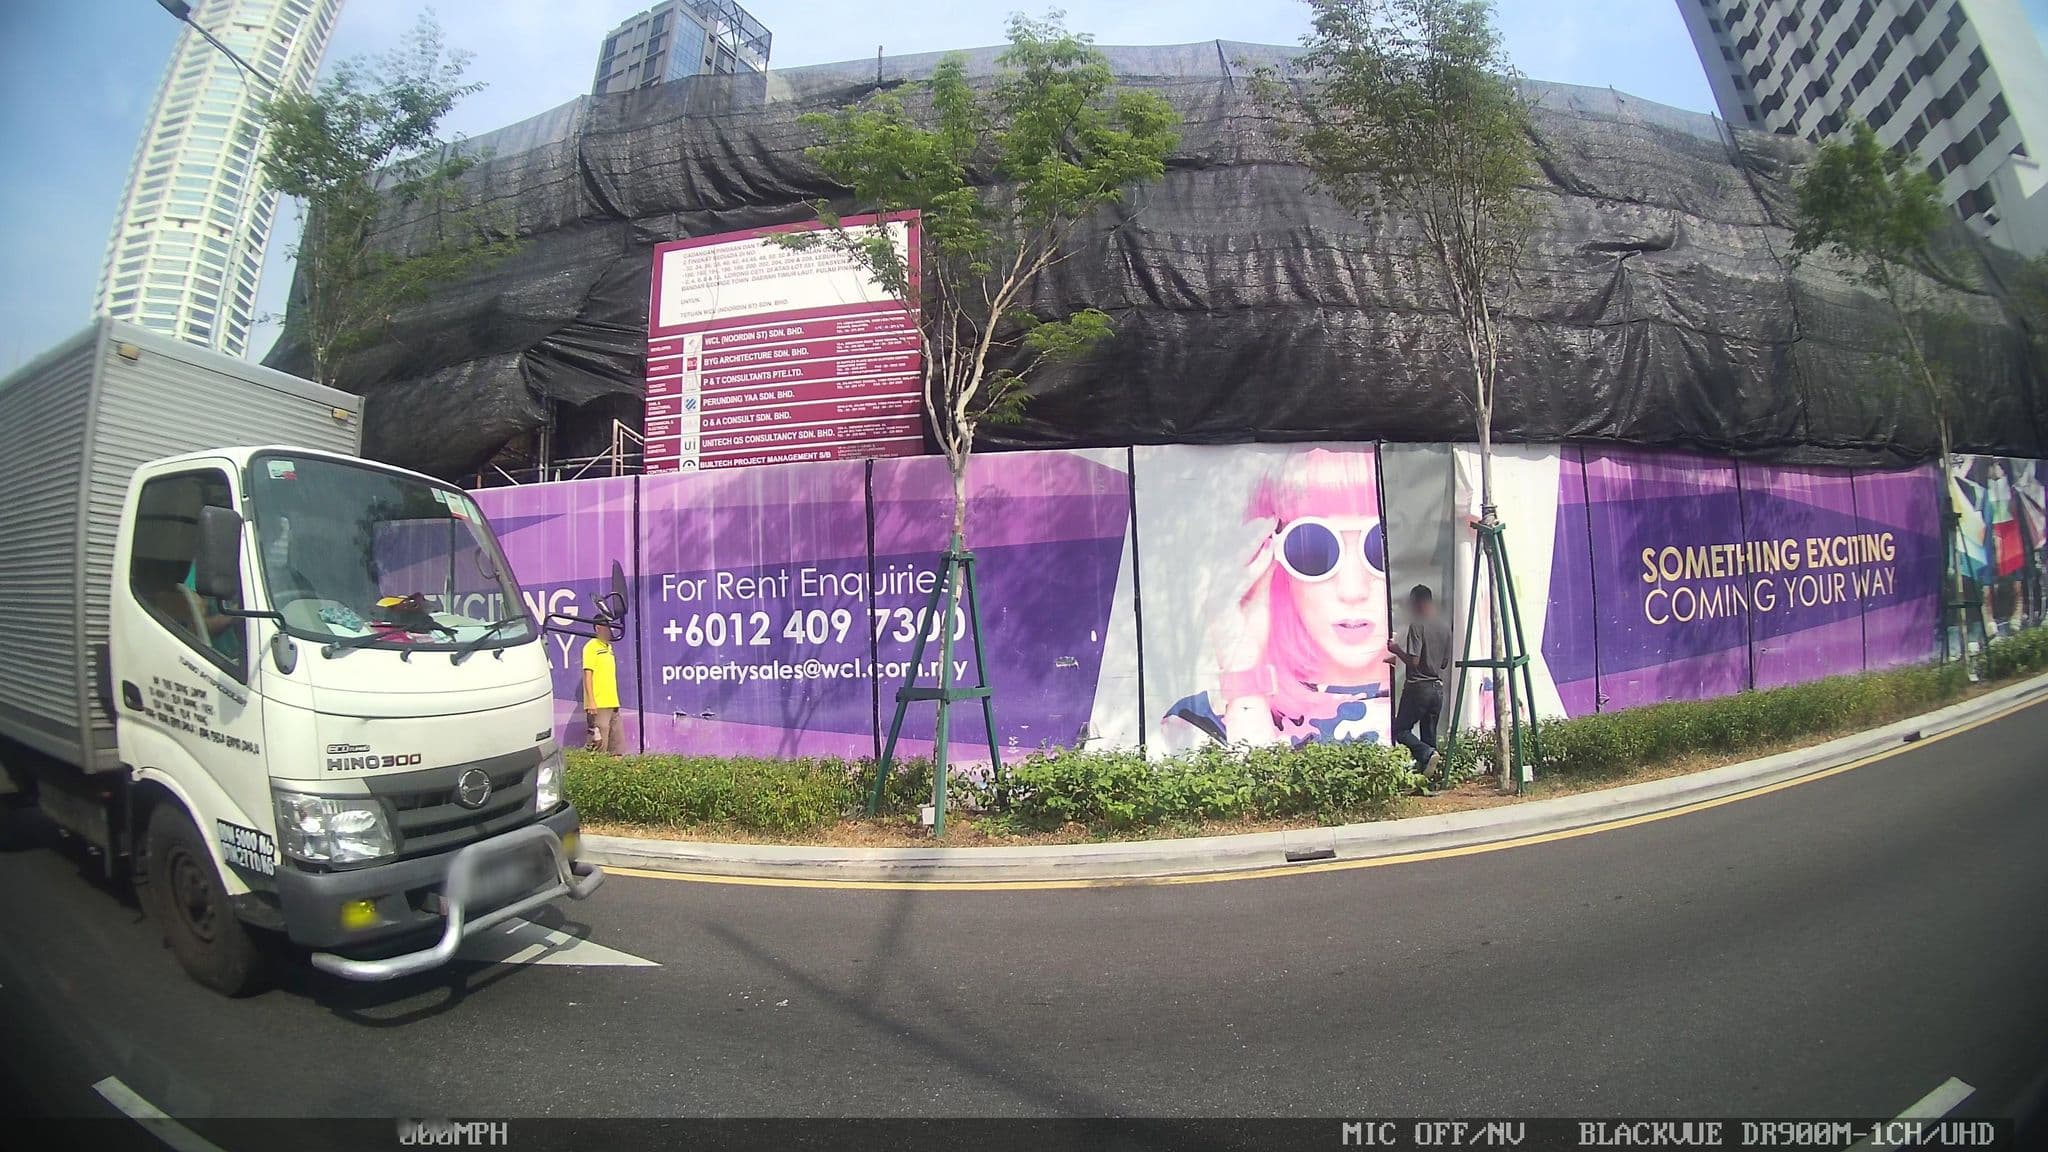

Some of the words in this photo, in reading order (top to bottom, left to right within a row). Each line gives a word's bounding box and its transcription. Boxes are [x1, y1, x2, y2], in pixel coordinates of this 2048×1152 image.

[705, 336, 720, 346] WCL
[722, 333, 756, 345] (NOORDIN
[756, 331, 768, 340] ST)
[768, 328, 786, 338] SDN.
[786, 326, 804, 336] BHD.
[704, 357, 719, 366] BYG
[720, 350, 772, 364] ARCHITECTURE
[774, 349, 790, 358] SDN.
[791, 347, 810, 356] BHD.
[703, 378, 709, 386] P
[715, 376, 721, 384] T
[722, 371, 772, 384] CONSULTANTS
[702, 394, 743, 406] PERUNDING
[744, 393, 759, 402] YAA
[759, 392, 776, 400] SDN.
[777, 390, 795, 398] BHD.
[710, 418, 716, 426] &
[716, 417, 722, 426] A
[722, 414, 755, 426] CONSULT
[756, 412, 772, 422] SDN.
[774, 411, 792, 420] BHD.
[702, 437, 733, 448] UNITECH
[745, 431, 797, 443] CONSULTANCY
[798, 430, 816, 439] SDN.
[817, 428, 835, 437] BHD.
[700, 458, 734, 469] BUILTECH
[734, 455, 766, 466] PROJECT
[766, 452, 818, 464] MANAGEMENT
[818, 451, 832, 459] S/B
[1642, 538, 1801, 584] SOMETHING
[1806, 532, 1896, 569] EXCITING
[662, 573, 707, 602] For
[716, 569, 788, 600] Rent
[1644, 578, 1776, 625] COMING
[1784, 572, 1847, 608] YOUR
[1852, 566, 1896, 600] WAY
[662, 611, 772, 647] +6012
[782, 608, 852, 645] 409
[327, 755, 380, 771] HINO
[382, 753, 422, 768] 300
